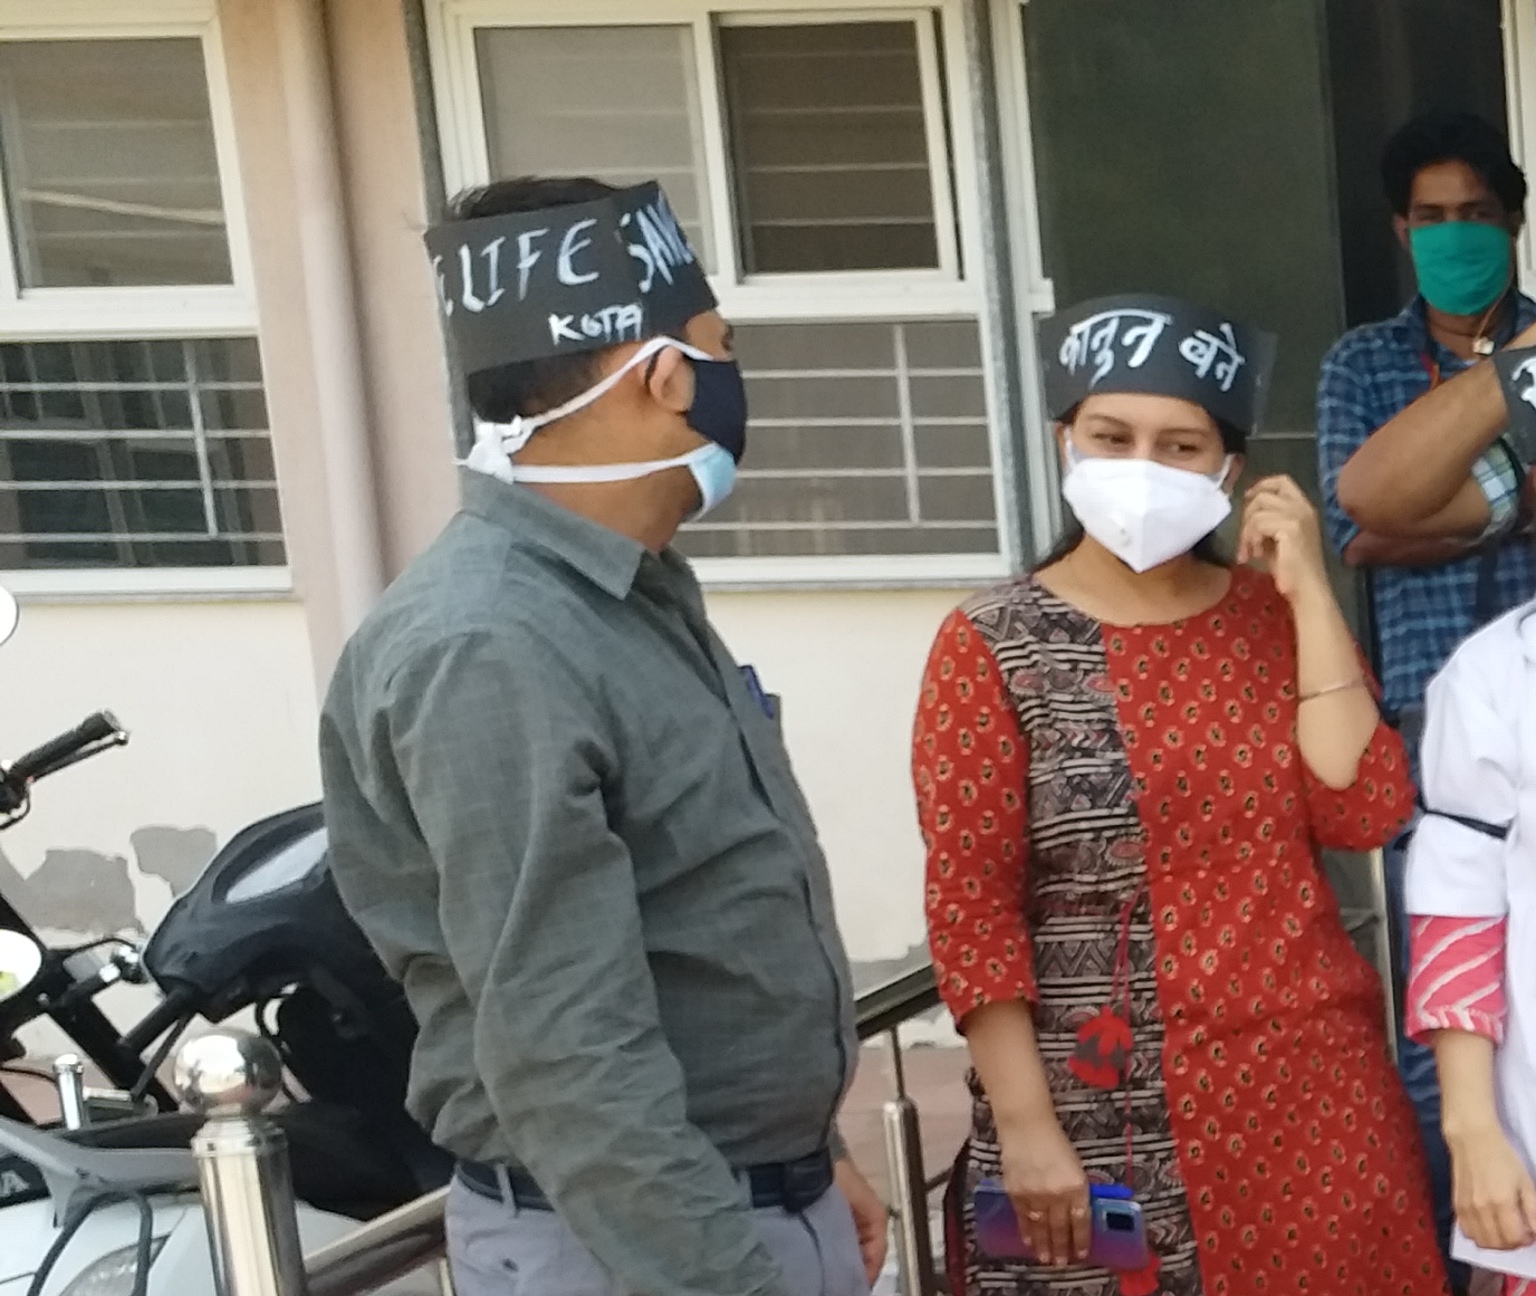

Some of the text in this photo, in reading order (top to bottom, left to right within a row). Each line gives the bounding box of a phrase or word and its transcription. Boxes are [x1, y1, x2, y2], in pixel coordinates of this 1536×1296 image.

[458, 217, 600, 313] LIFE
[547, 301, 644, 346] KOTA
[1178, 321, 1246, 392] बने
